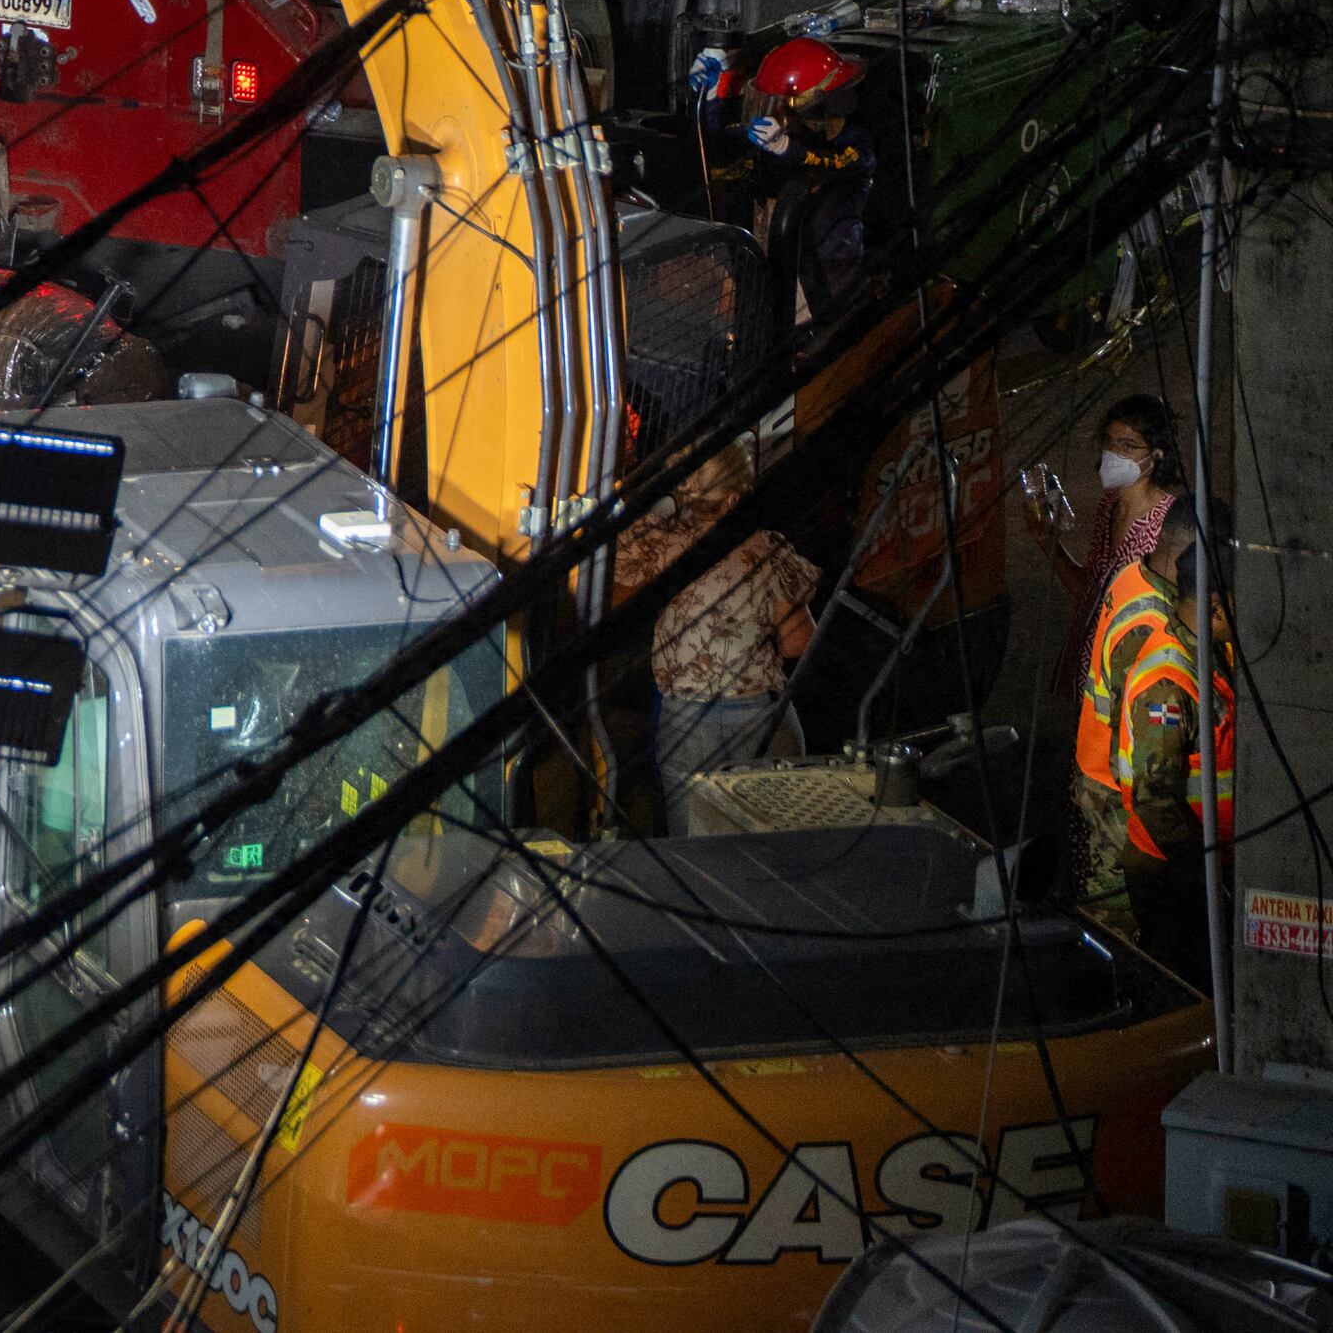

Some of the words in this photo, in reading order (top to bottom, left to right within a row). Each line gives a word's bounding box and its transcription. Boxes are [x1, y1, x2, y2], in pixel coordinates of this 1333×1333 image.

[1251, 895, 1302, 920] ANTENA
[377, 1140, 591, 1199] MOPC
[604, 1116, 1098, 1266] CASE
